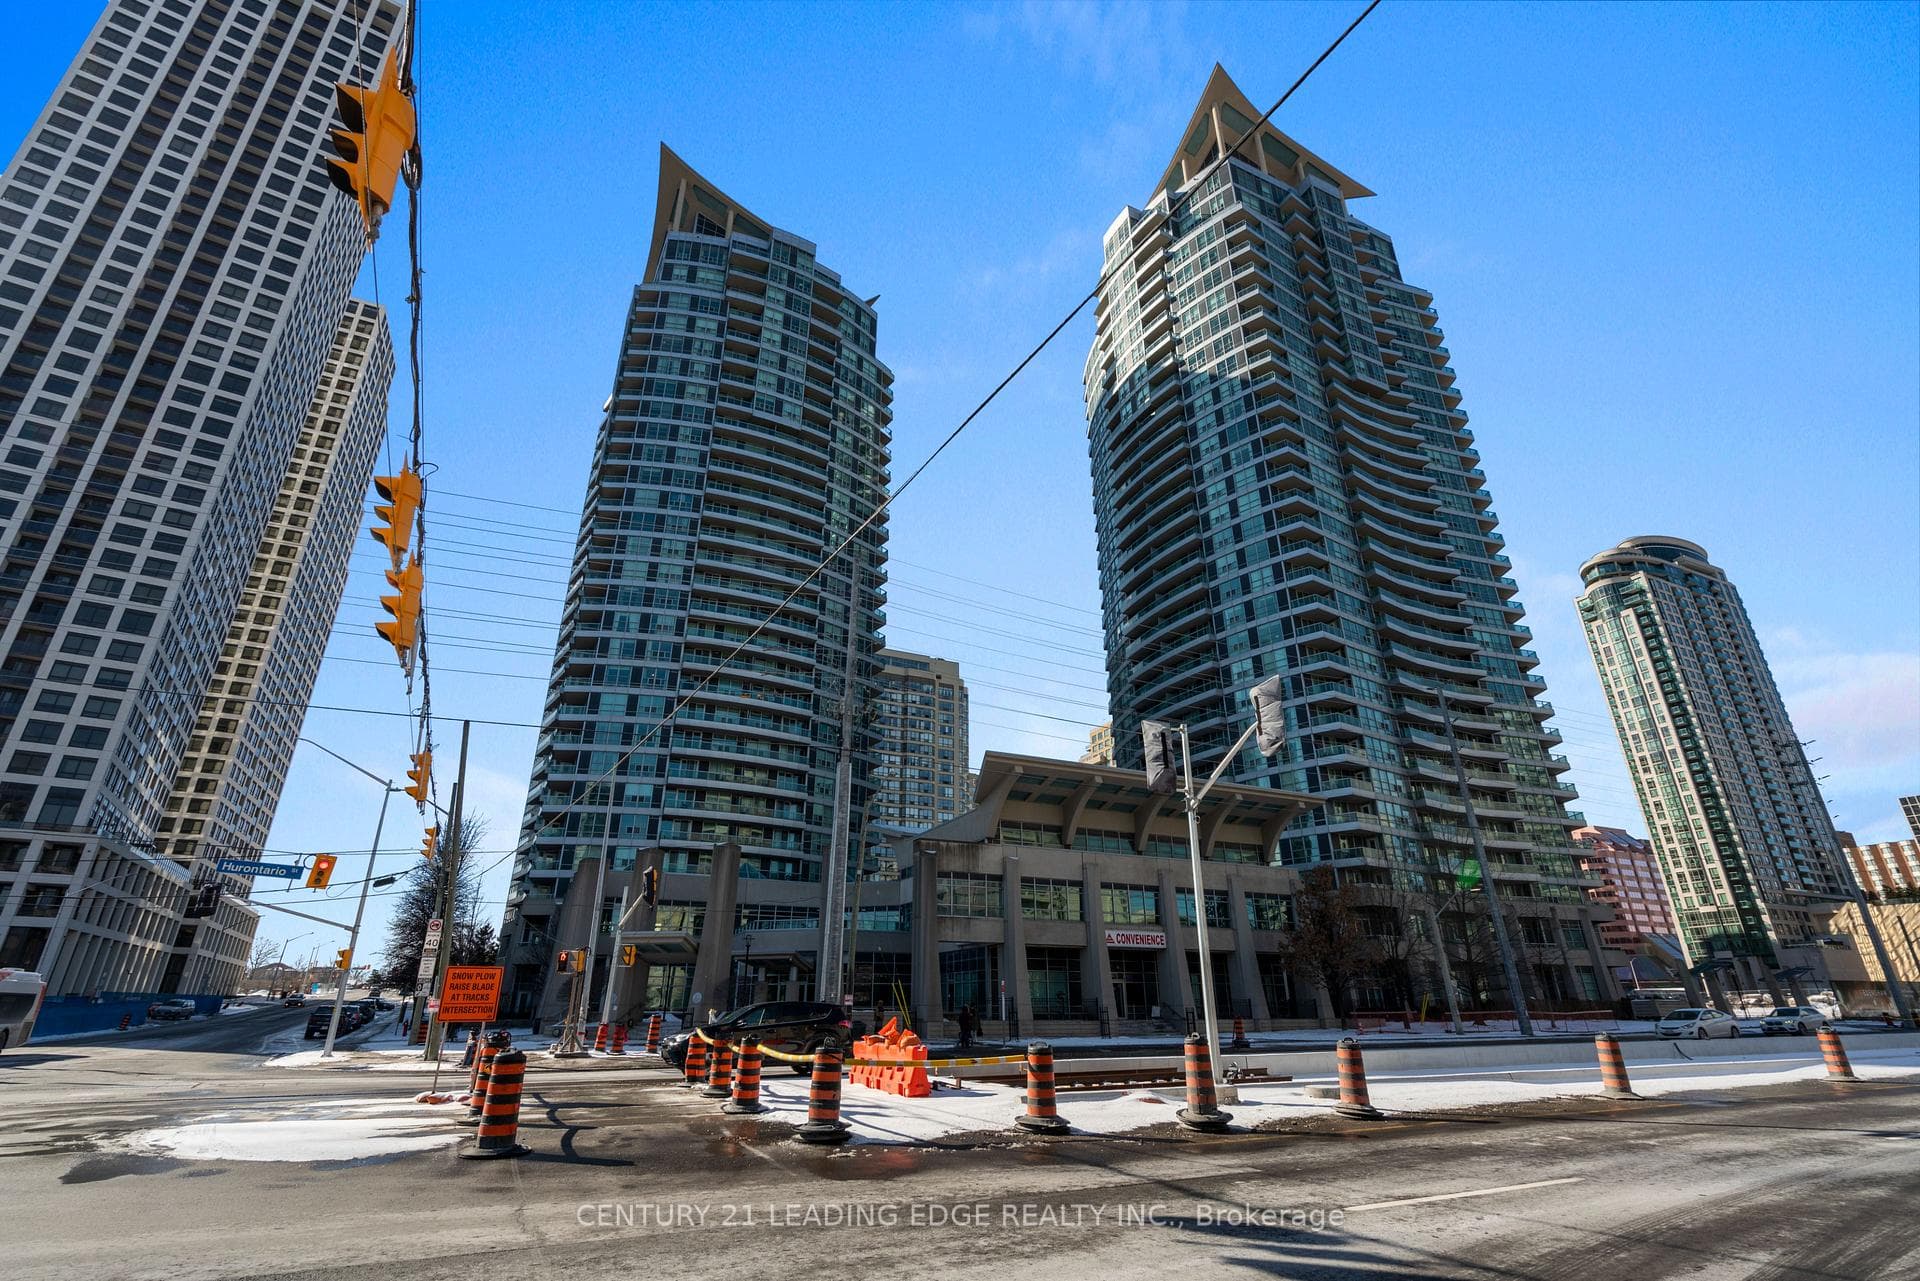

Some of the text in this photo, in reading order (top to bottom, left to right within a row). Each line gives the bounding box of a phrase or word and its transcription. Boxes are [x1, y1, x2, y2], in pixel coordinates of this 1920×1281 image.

[221, 861, 287, 876] Hurontario
[426, 939, 438, 947] 40
[1116, 933, 1165, 945] CONVENIENCE
[451, 972, 496, 980] SNOW PLOW
[450, 993, 490, 1001] AT TRACKS
[442, 1005, 493, 1014] INTERSECTION
